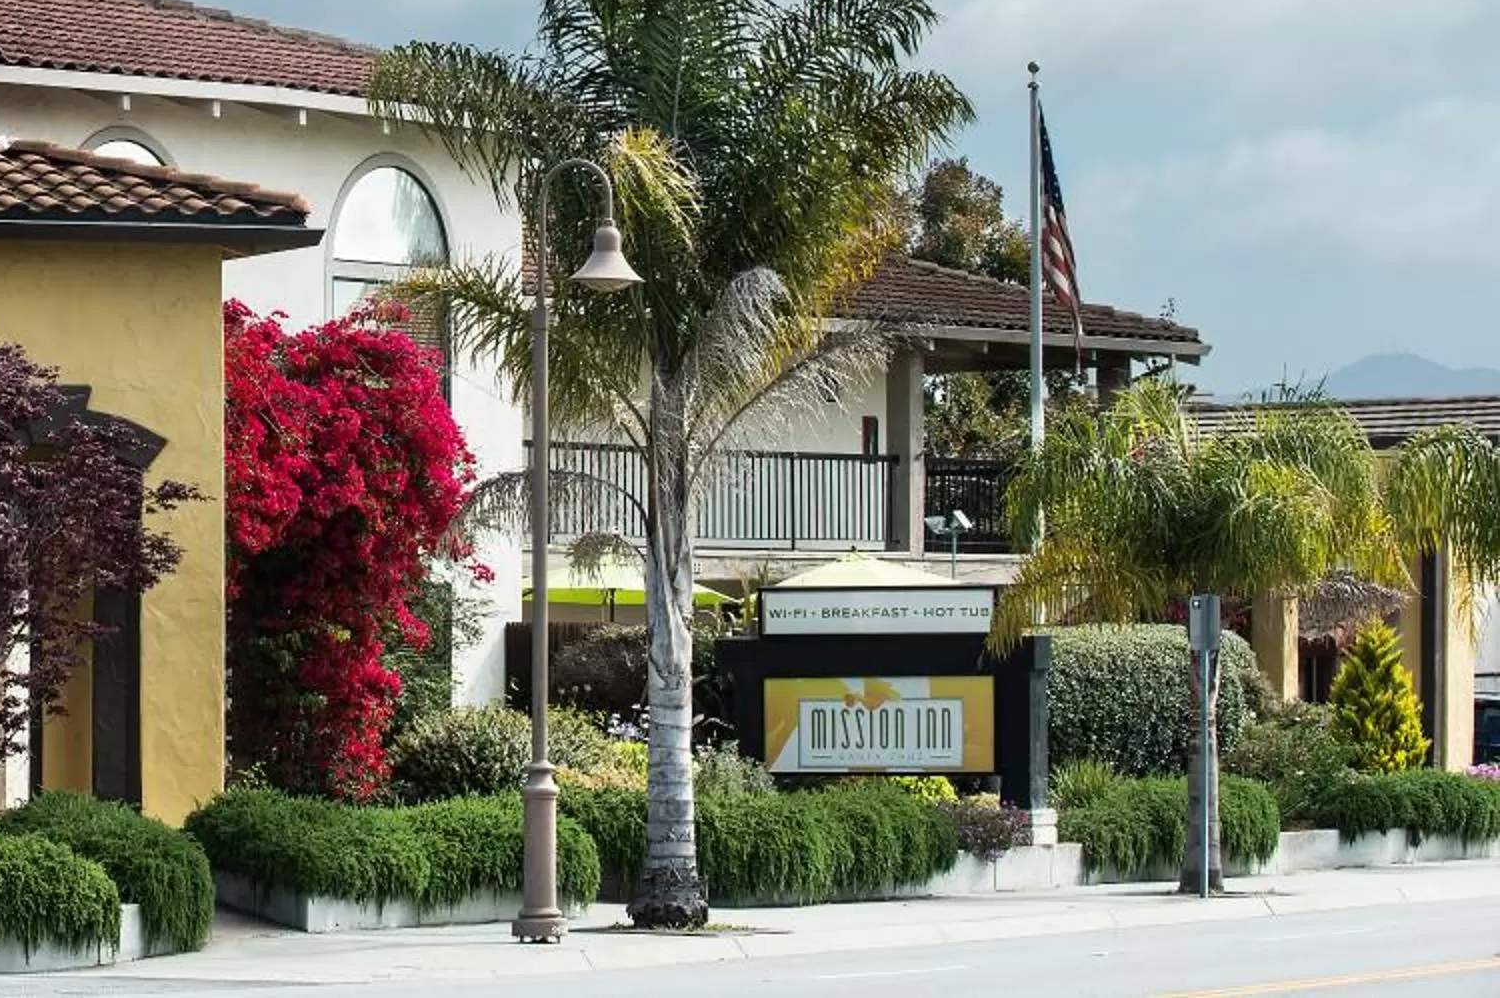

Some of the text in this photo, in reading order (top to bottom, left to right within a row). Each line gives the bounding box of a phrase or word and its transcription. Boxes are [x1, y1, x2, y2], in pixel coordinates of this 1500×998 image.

[821, 607, 909, 619] BREAKFAST
[923, 607, 955, 617] HOT
[960, 607, 990, 617] TUB
[811, 707, 952, 750] MISSION INN
